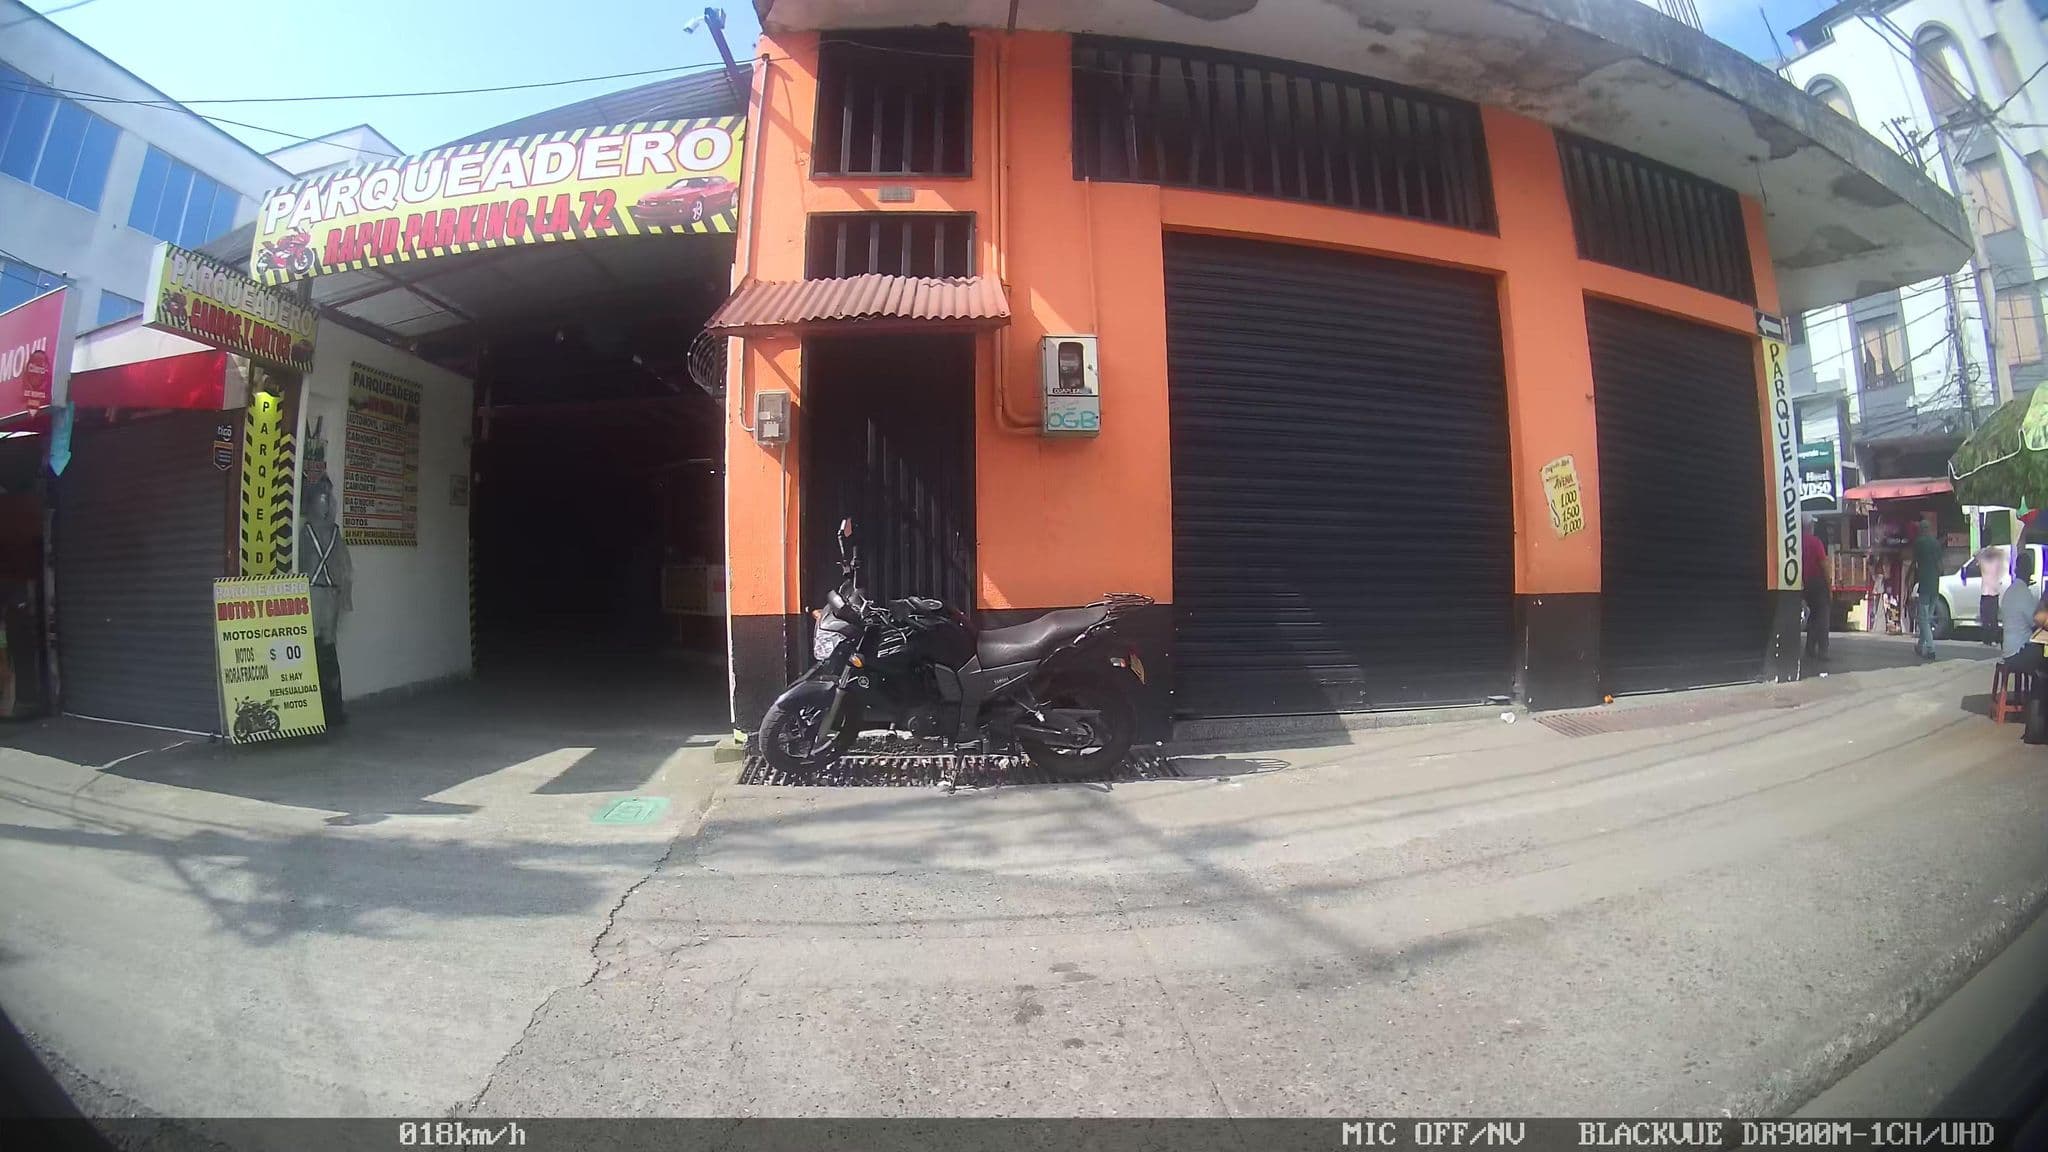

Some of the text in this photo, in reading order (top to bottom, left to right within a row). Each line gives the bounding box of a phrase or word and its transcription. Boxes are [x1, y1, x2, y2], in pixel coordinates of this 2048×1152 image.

[263, 127, 733, 235] PARQUEADERO
[322, 189, 617, 265] RAPID PARKING LA 72
[170, 254, 314, 337] PARQUEADERO
[190, 299, 292, 361] CARROS Y MOTOS
[353, 371, 420, 406] PARQUEADERO
[1769, 343, 1798, 587] PARQUEADERO
[256, 401, 271, 576] PARQUEAD
[215, 583, 308, 599] PARQUEADERO
[217, 597, 309, 621] MOTOS Y CARROS
[223, 626, 307, 642] MOTOS/CARROS
[234, 647, 255, 664] MOTOS
[286, 645, 301, 659] 00
[270, 684, 318, 697] MENSUALIDAD
[289, 672, 303, 681] HAY
[283, 700, 308, 709] MOTOS
